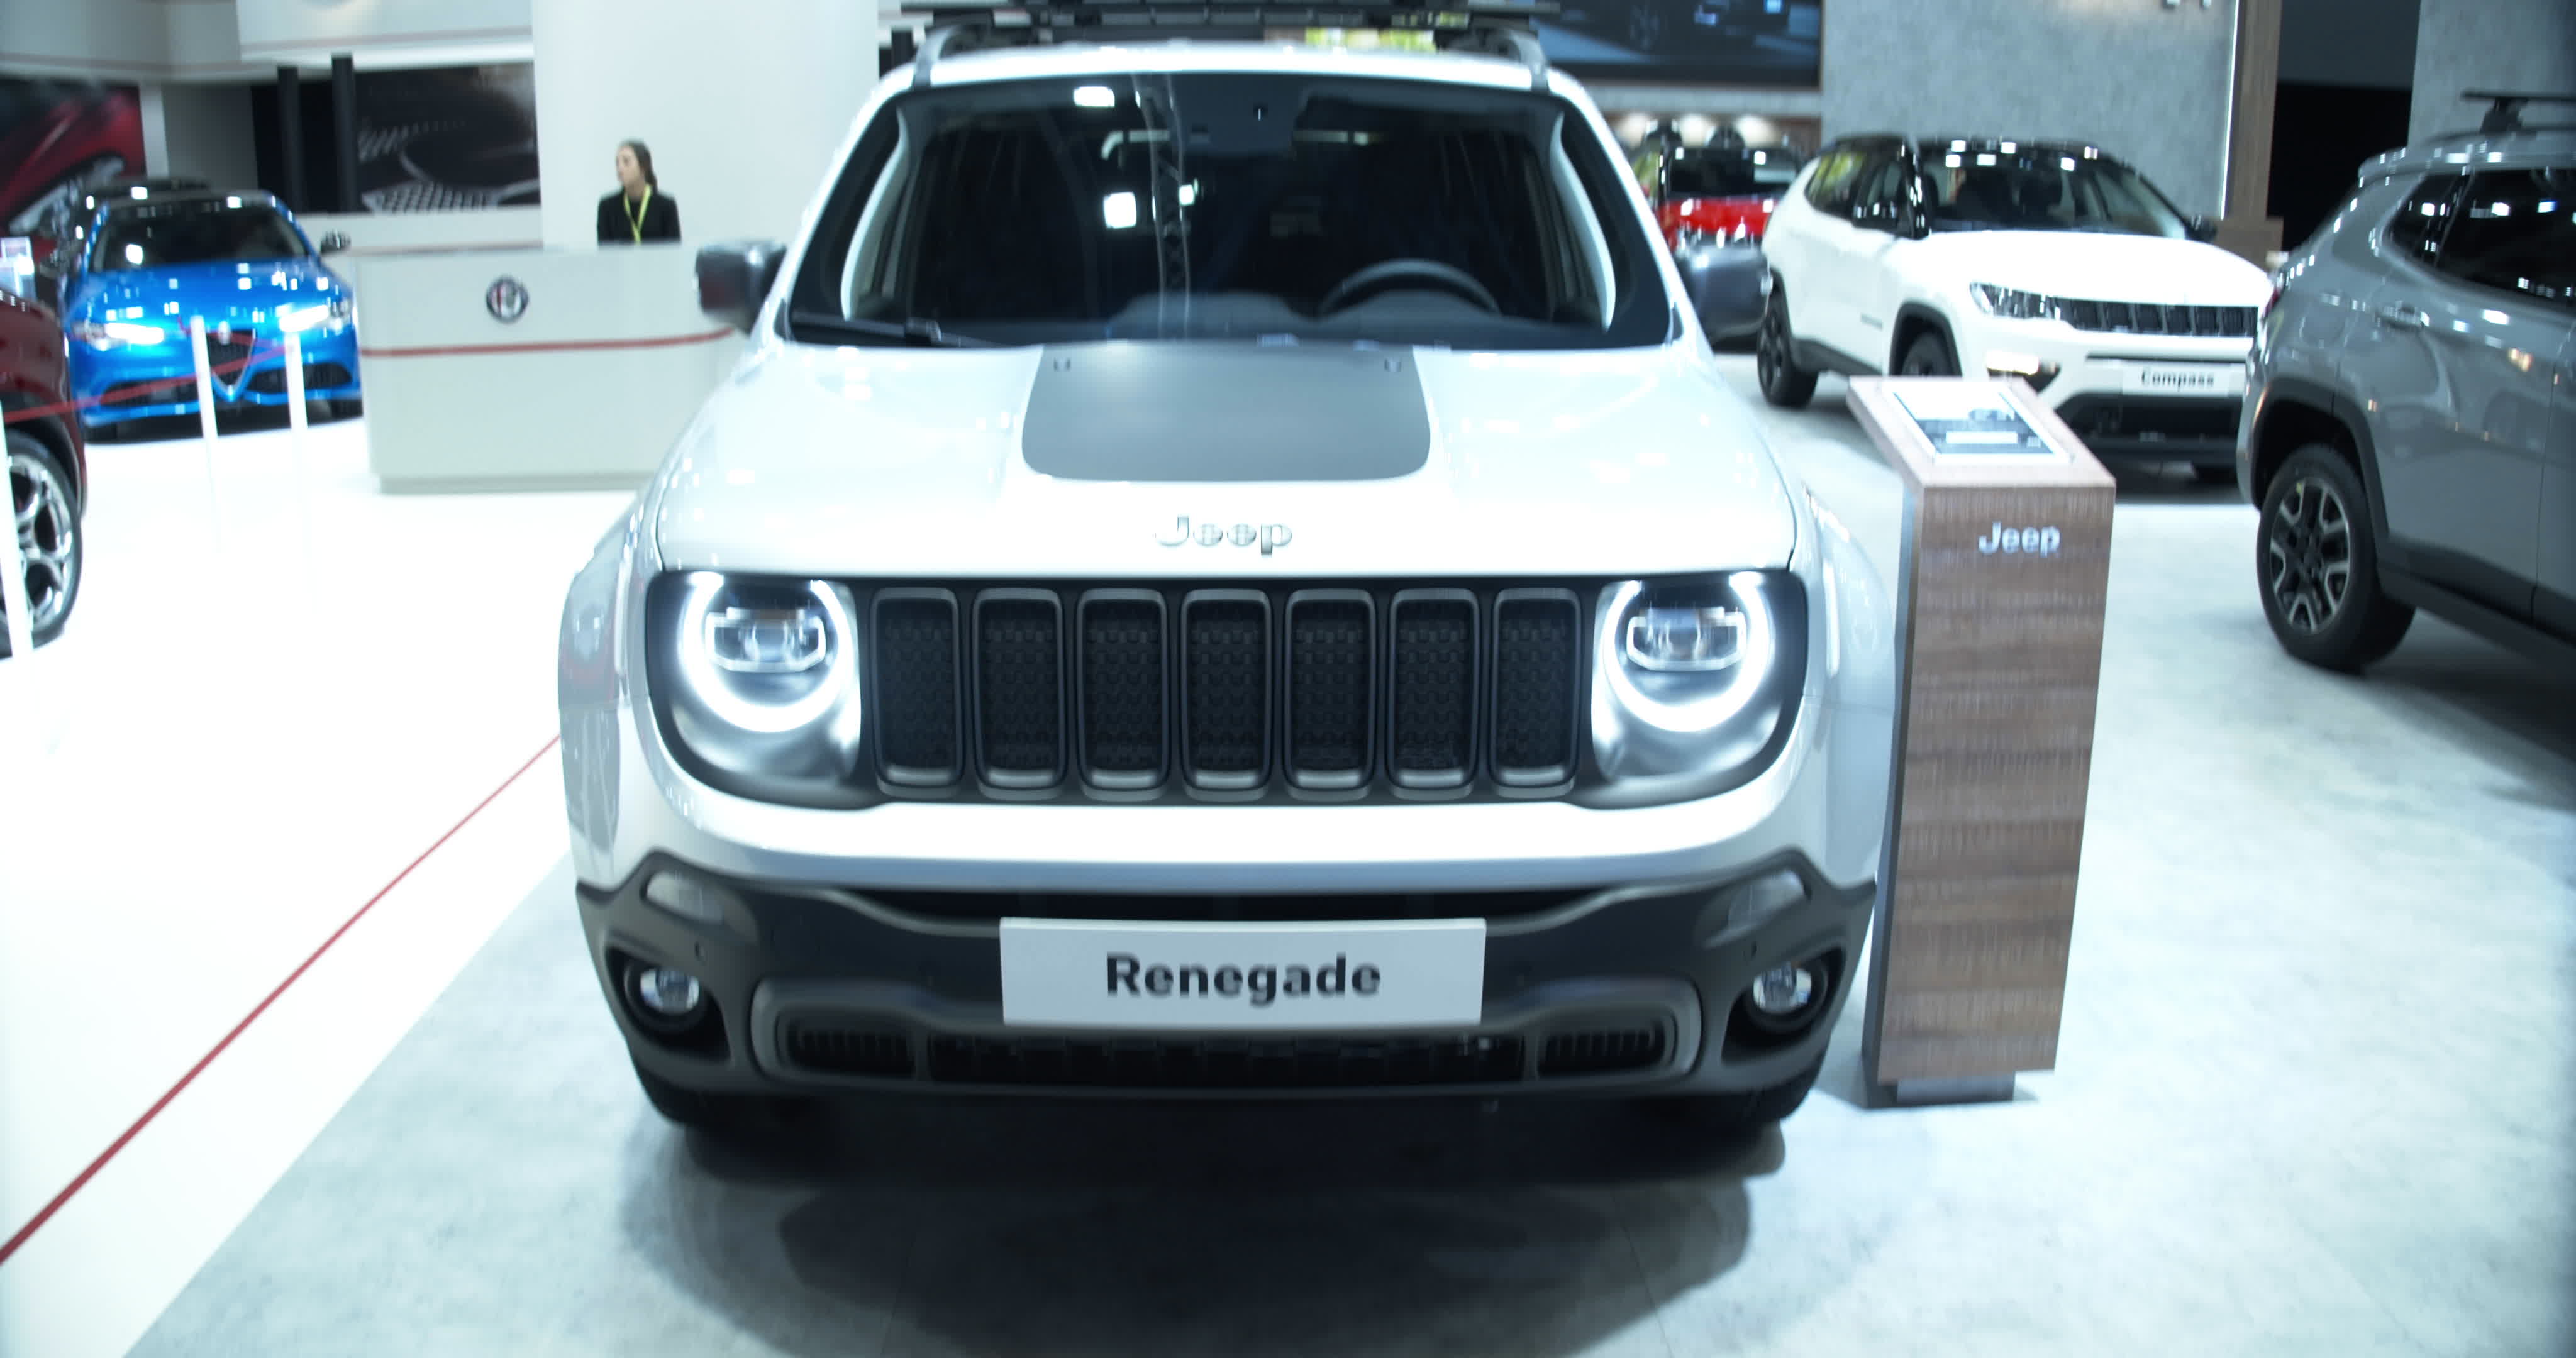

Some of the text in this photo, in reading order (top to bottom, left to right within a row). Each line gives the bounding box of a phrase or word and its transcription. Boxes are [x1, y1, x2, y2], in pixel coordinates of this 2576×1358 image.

[2141, 368, 2214, 392] Compass
[1155, 514, 1293, 557] Jeep
[1979, 521, 2060, 558] Jeep
[1106, 952, 1381, 1007] Renegade
